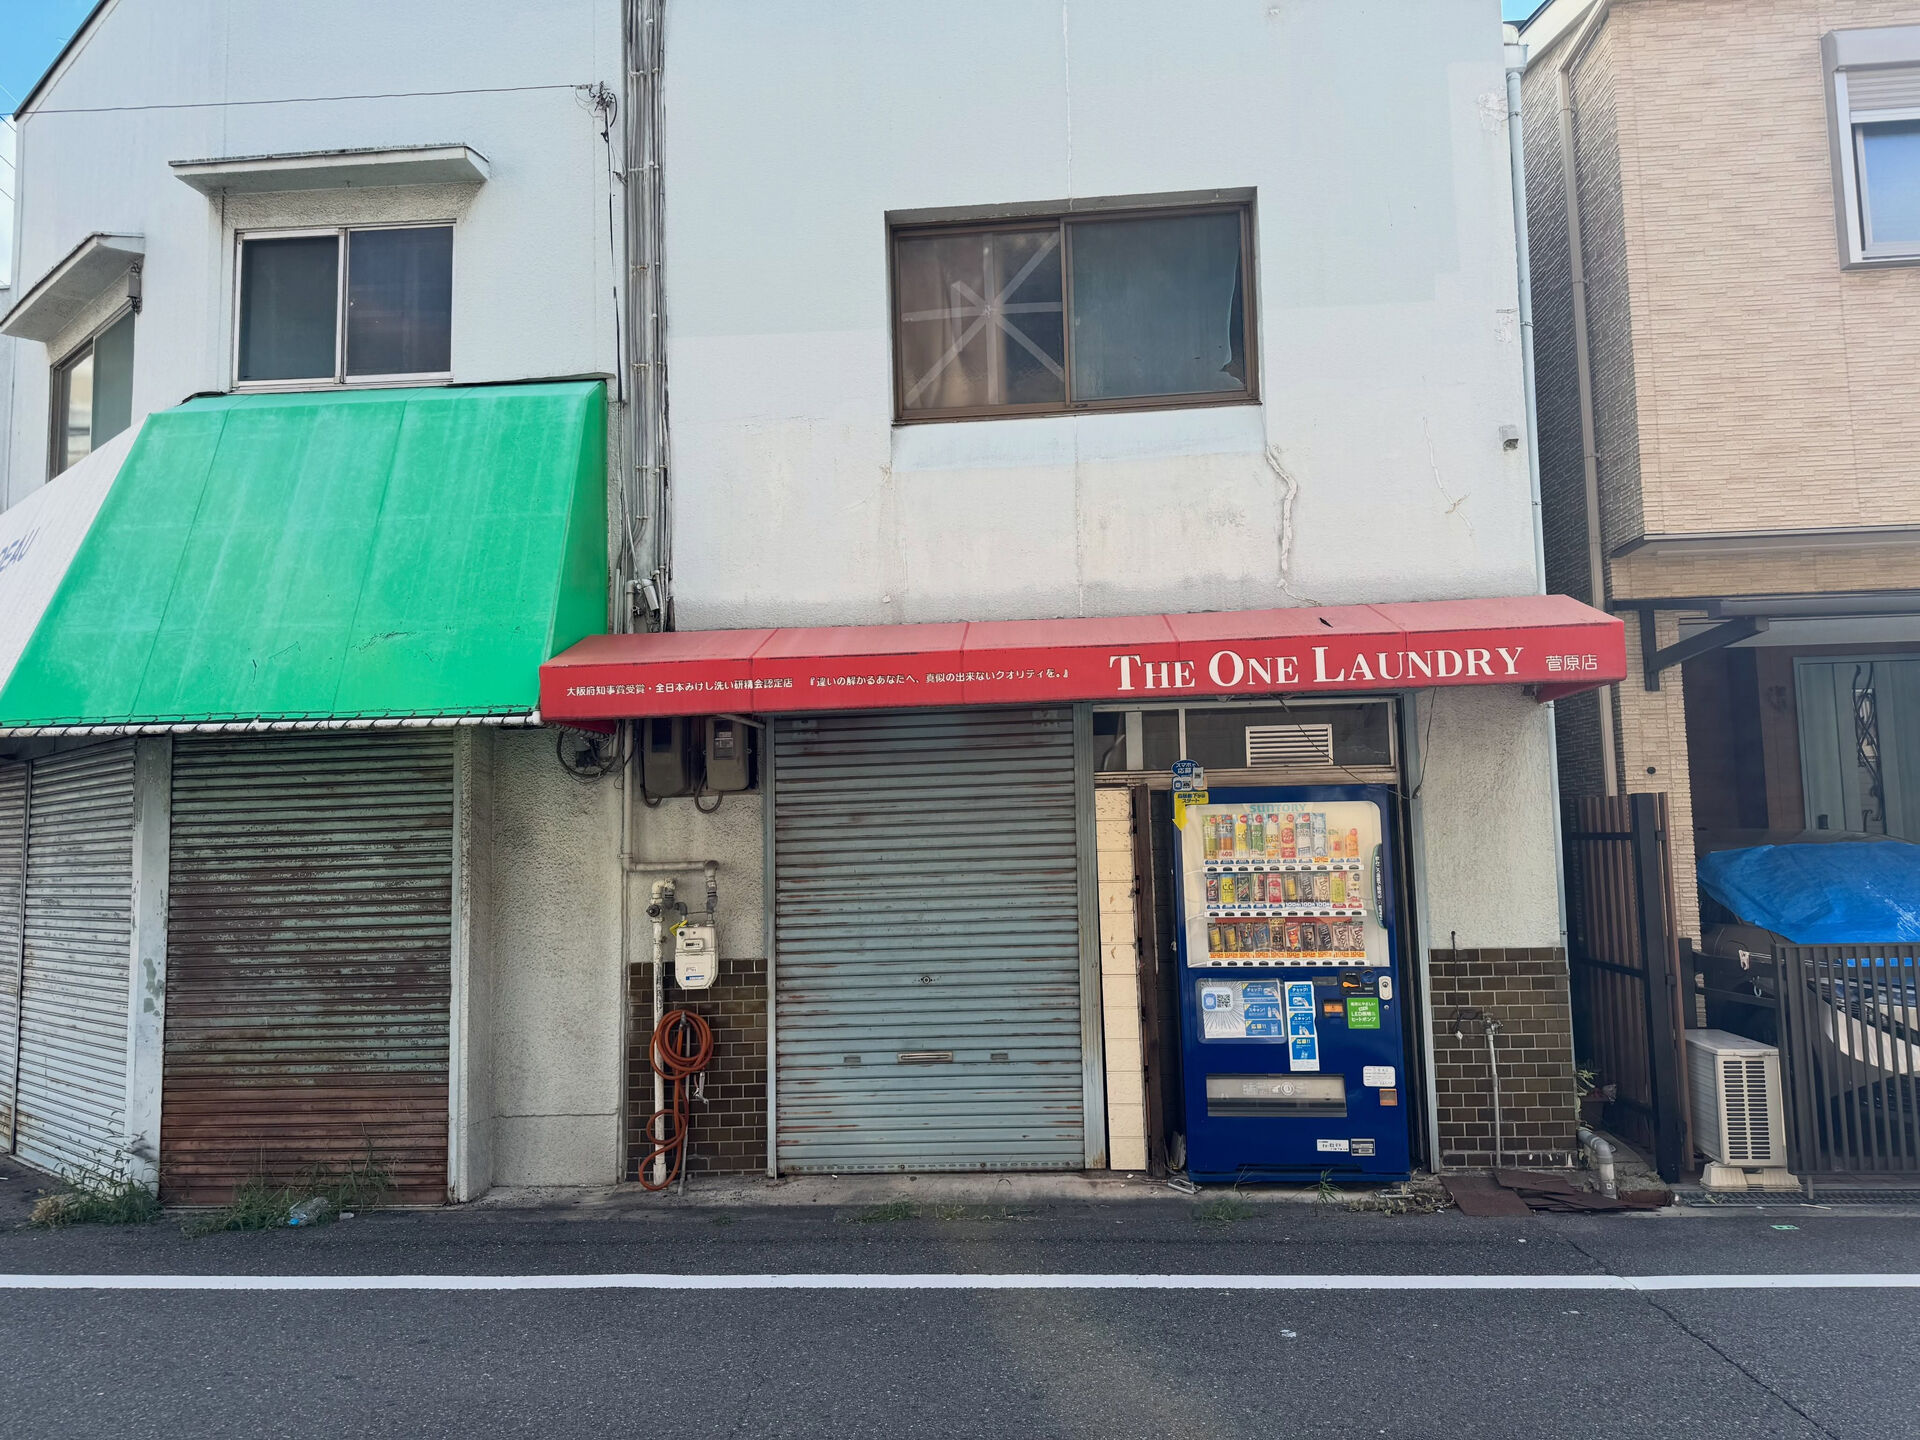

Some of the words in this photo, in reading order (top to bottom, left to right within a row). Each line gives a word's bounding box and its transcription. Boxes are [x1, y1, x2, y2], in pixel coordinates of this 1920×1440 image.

[1109, 654, 1196, 691] THE
[1208, 650, 1299, 687] ONE
[1311, 646, 1524, 683] LAUNDRY
[1545, 654, 1598, 672] 菅原店
